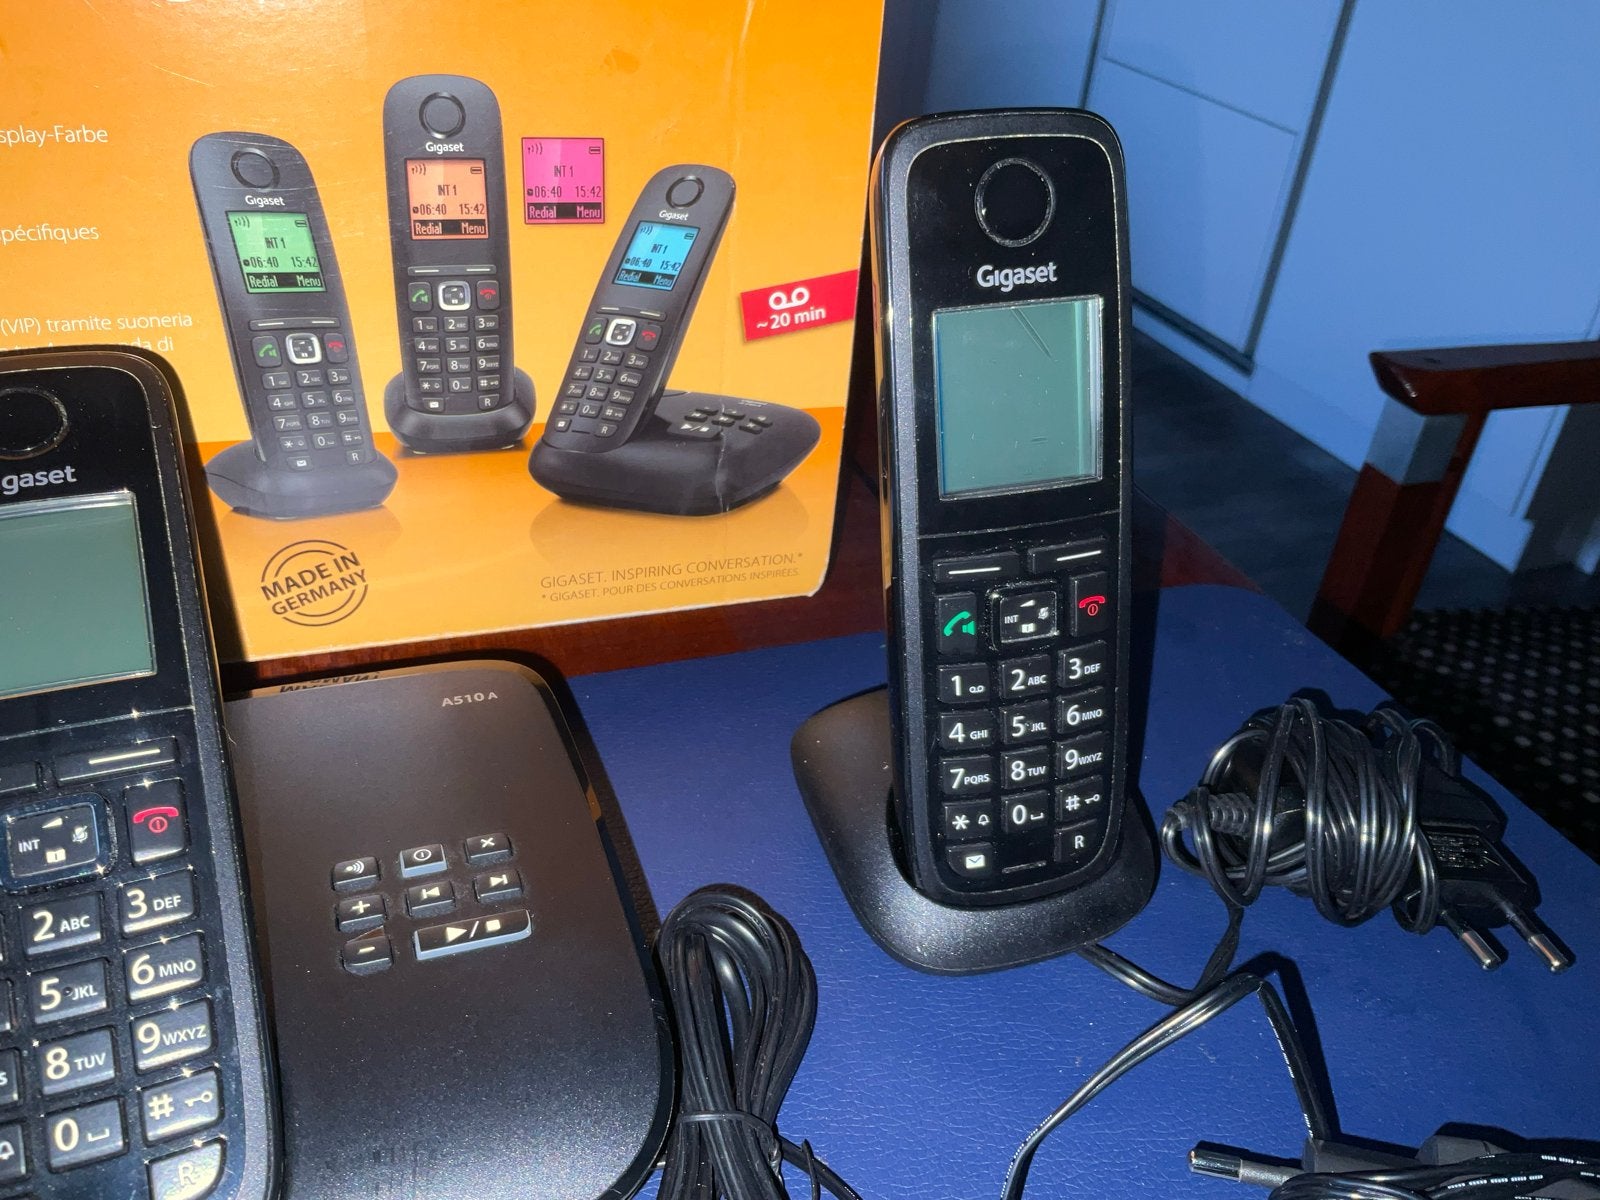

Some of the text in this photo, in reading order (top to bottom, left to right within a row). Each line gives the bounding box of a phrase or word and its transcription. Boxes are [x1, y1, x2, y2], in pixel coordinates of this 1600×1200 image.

[425, 142, 464, 155] Gigaset
[554, 166, 568, 178] INT
[438, 185, 451, 196] INT
[534, 186, 601, 198] 06:40 15:42
[245, 195, 286, 207] Gigaset
[420, 203, 485, 215] 06:40 15:42
[529, 207, 601, 219] Redial Menu
[659, 210, 689, 221] Gigaset
[0, 223, 100, 246] pécifiques
[415, 223, 485, 235] Redial Menu
[265, 237, 278, 249] INT
[250, 256, 318, 268] 06:40 15:42
[250, 276, 321, 288] Redial Menu
[976, 262, 1058, 293] Gigaset
[794, 306, 827, 324] min
[0, 314, 193, 336] (VIP) tramite suoneria
[449, 320, 456, 330] 2
[479, 318, 486, 329] 3
[158, 336, 174, 352] di
[419, 342, 426, 351] 4
[450, 341, 457, 350] 5
[479, 339, 486, 349] 6
[420, 361, 427, 371] 7
[451, 361, 458, 370] 8
[479, 359, 486, 369] 9
[269, 376, 275, 387] 1
[302, 373, 310, 384] 2
[332, 372, 339, 382] 3
[273, 398, 281, 408] 4
[308, 395, 315, 405] 5
[335, 393, 343, 403] 6
[278, 419, 285, 429] 7
[312, 416, 320, 426] 8
[340, 413, 347, 423] 9
[1, 465, 78, 495] gaset
[261, 552, 361, 601] MADE IN
[540, 571, 607, 588] GIGASET.
[612, 564, 682, 581] INSPIRING
[603, 585, 634, 596] POUR
[637, 583, 657, 593] DES
[660, 573, 747, 590] CONVERSATIONS
[272, 569, 366, 615] GERMANY
[1005, 615, 1019, 624] INT
[1069, 658, 1101, 679] 3 DEF
[952, 675, 962, 696] 1
[1012, 669, 1047, 690] 2 ABC
[442, 692, 485, 707] A510
[1067, 705, 1103, 726] 6 MNO
[949, 722, 988, 742] 4 GHI
[1012, 716, 1047, 737] 5 JKL
[1065, 750, 1102, 770] 9 WXYZ
[1011, 761, 1046, 781] 8 TUV
[950, 768, 990, 789] 7 PQRS
[1013, 805, 1026, 825] 0
[18, 839, 40, 853] INT
[1075, 835, 1084, 849] R
[127, 889, 182, 919] 3 DEF
[33, 910, 90, 942] 2 ABC
[132, 954, 197, 985] 6 MNO
[40, 978, 99, 1011] 5 JKL
[138, 1023, 207, 1054] 9 WXYZ
[46, 1048, 106, 1080] 8 TUV
[55, 1118, 79, 1152] 0
